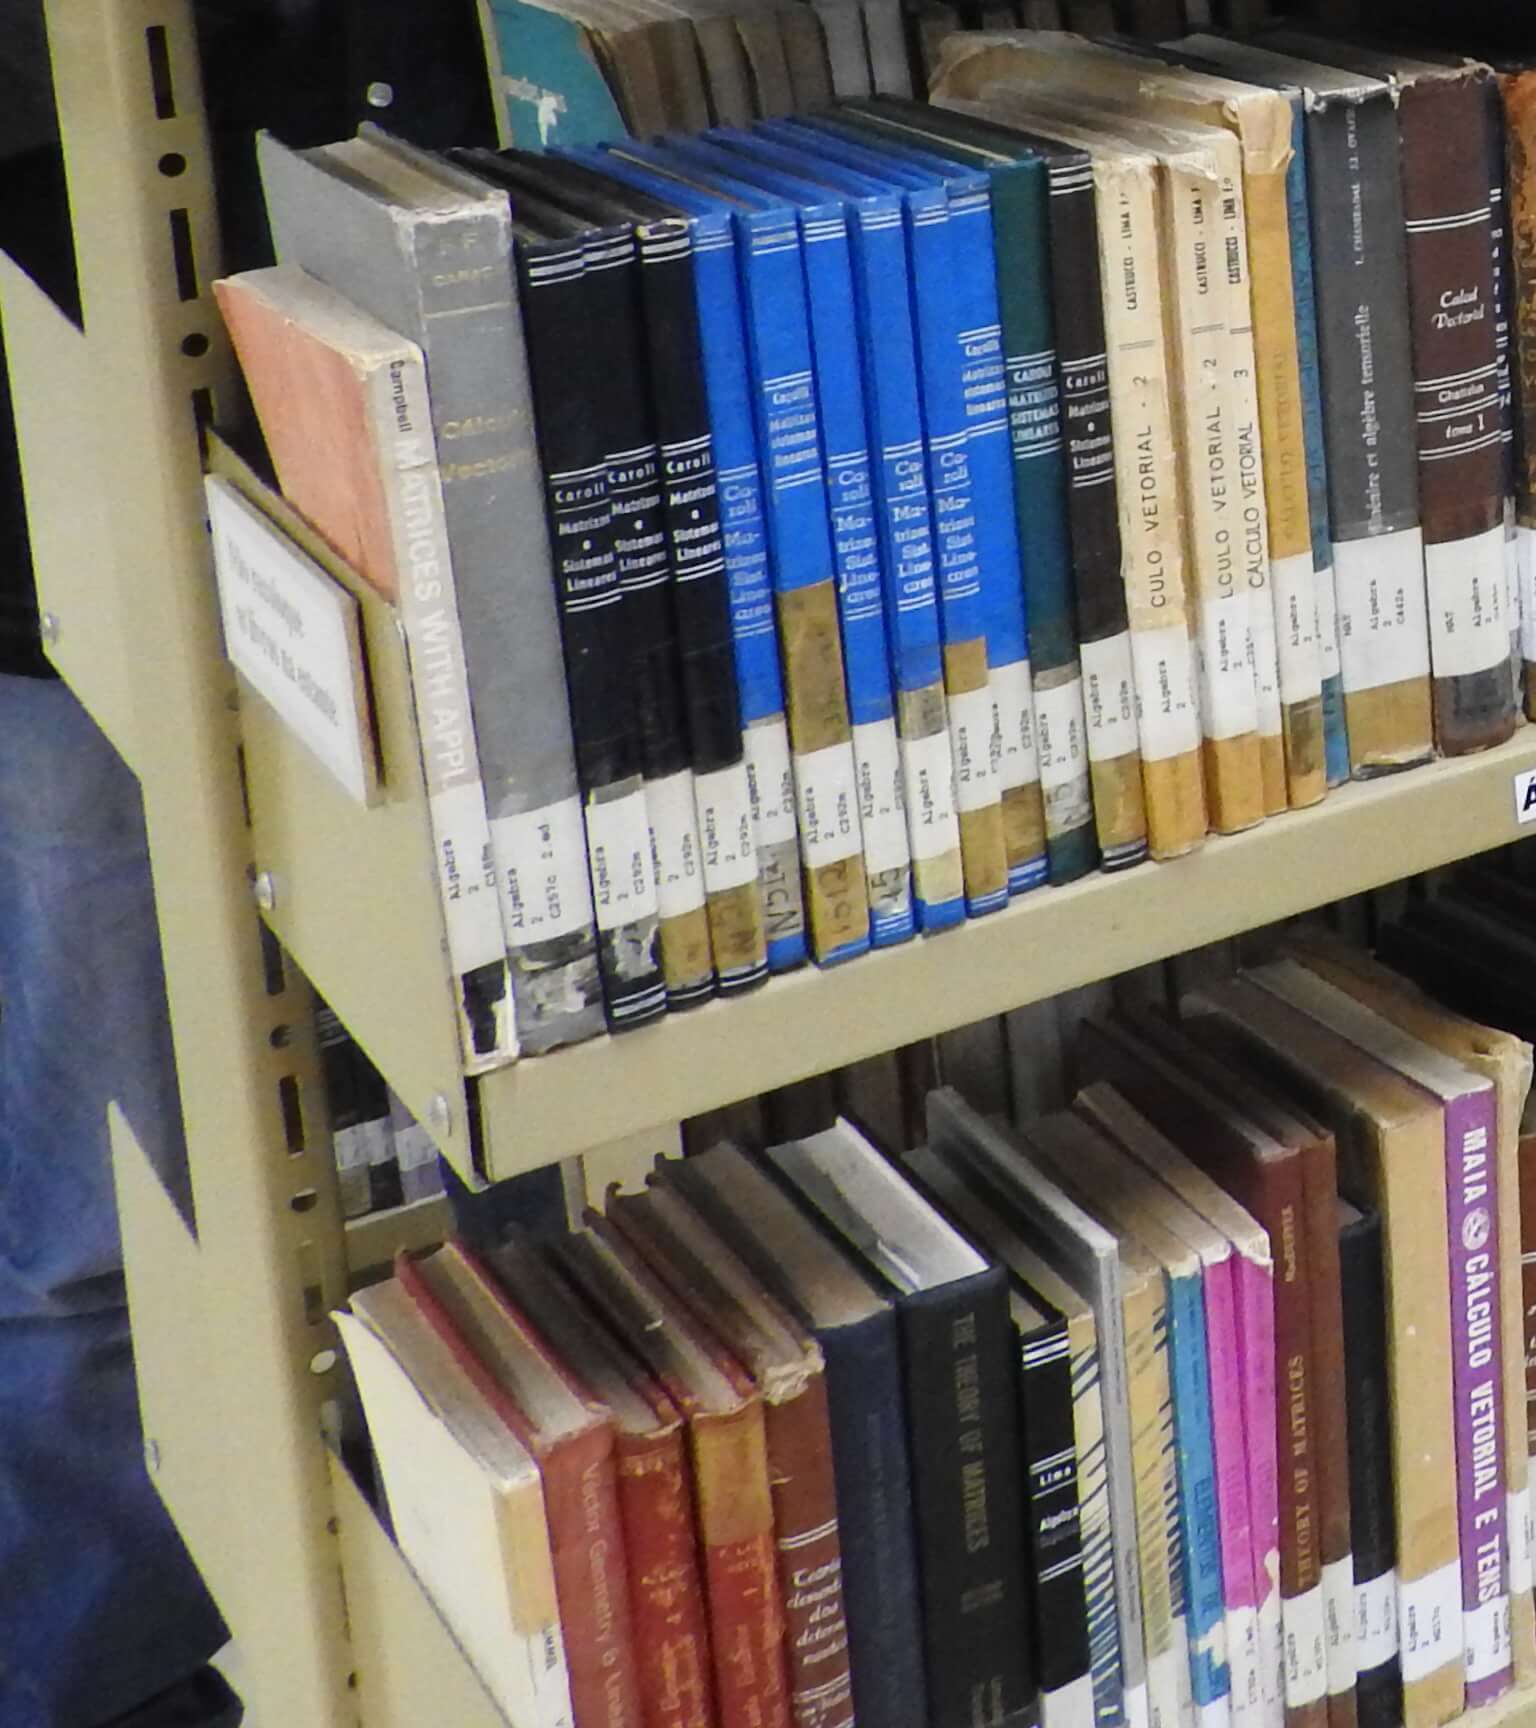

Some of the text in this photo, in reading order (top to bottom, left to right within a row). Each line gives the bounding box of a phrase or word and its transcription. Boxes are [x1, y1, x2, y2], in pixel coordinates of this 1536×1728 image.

[1122, 202, 1134, 240] LIMA
[388, 358, 413, 434] Campbell
[555, 481, 606, 504] Caroli
[607, 462, 656, 484] Caroli
[665, 451, 712, 474] Caroli
[1137, 423, 1160, 534] VETORIAL
[1207, 406, 1227, 513] VETORIAL
[1238, 421, 1258, 501] VETORIAL
[394, 435, 442, 602] MATRICES
[1463, 1126, 1495, 1530] MAIA CÁLCULO VETORIAL E
